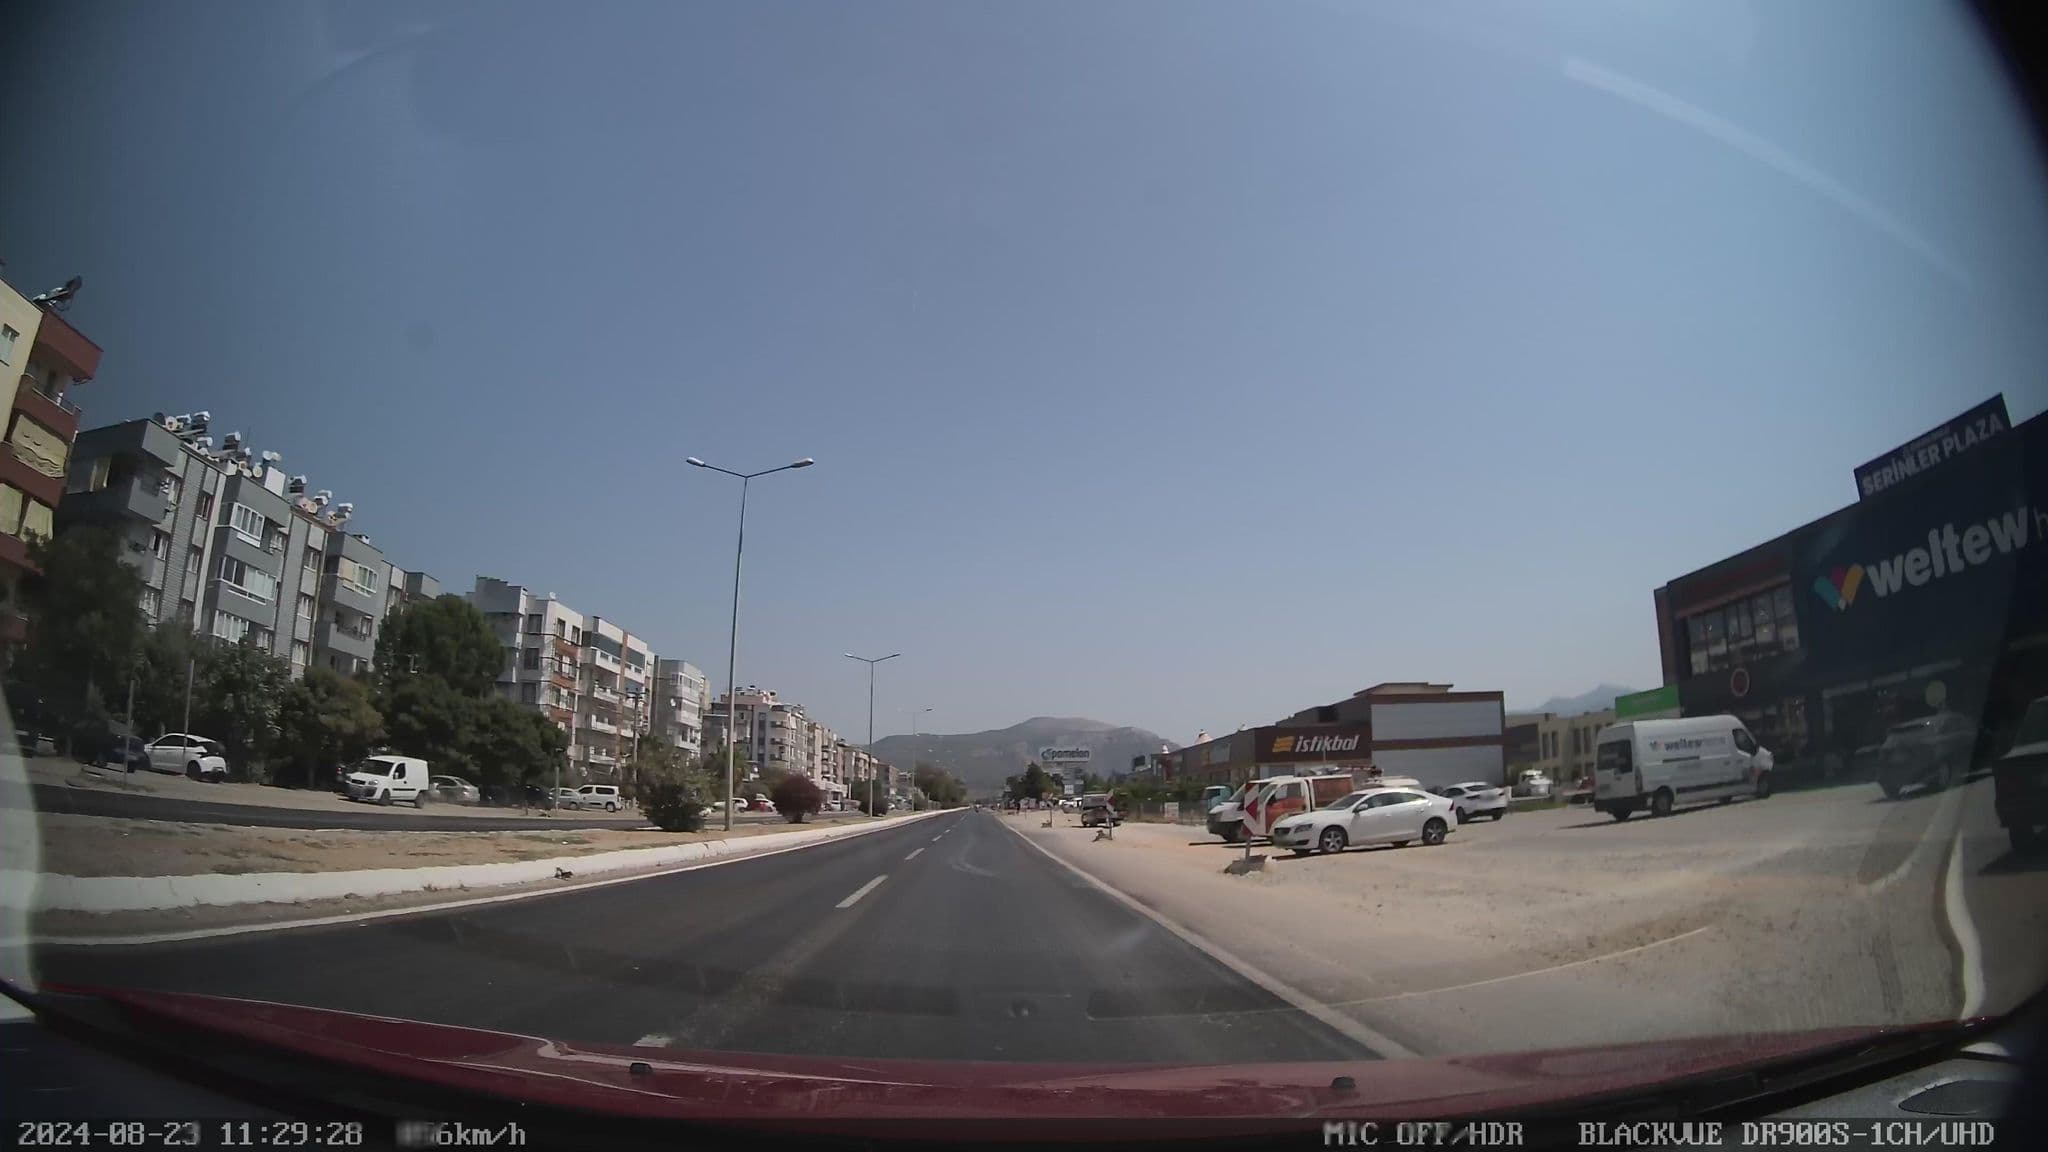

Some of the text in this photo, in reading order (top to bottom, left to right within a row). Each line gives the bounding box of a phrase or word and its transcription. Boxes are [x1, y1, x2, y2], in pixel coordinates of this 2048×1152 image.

[1942, 413, 2004, 460] PLAZA
[1866, 505, 2028, 598] weltew
[1295, 735, 1360, 753] istikbal
